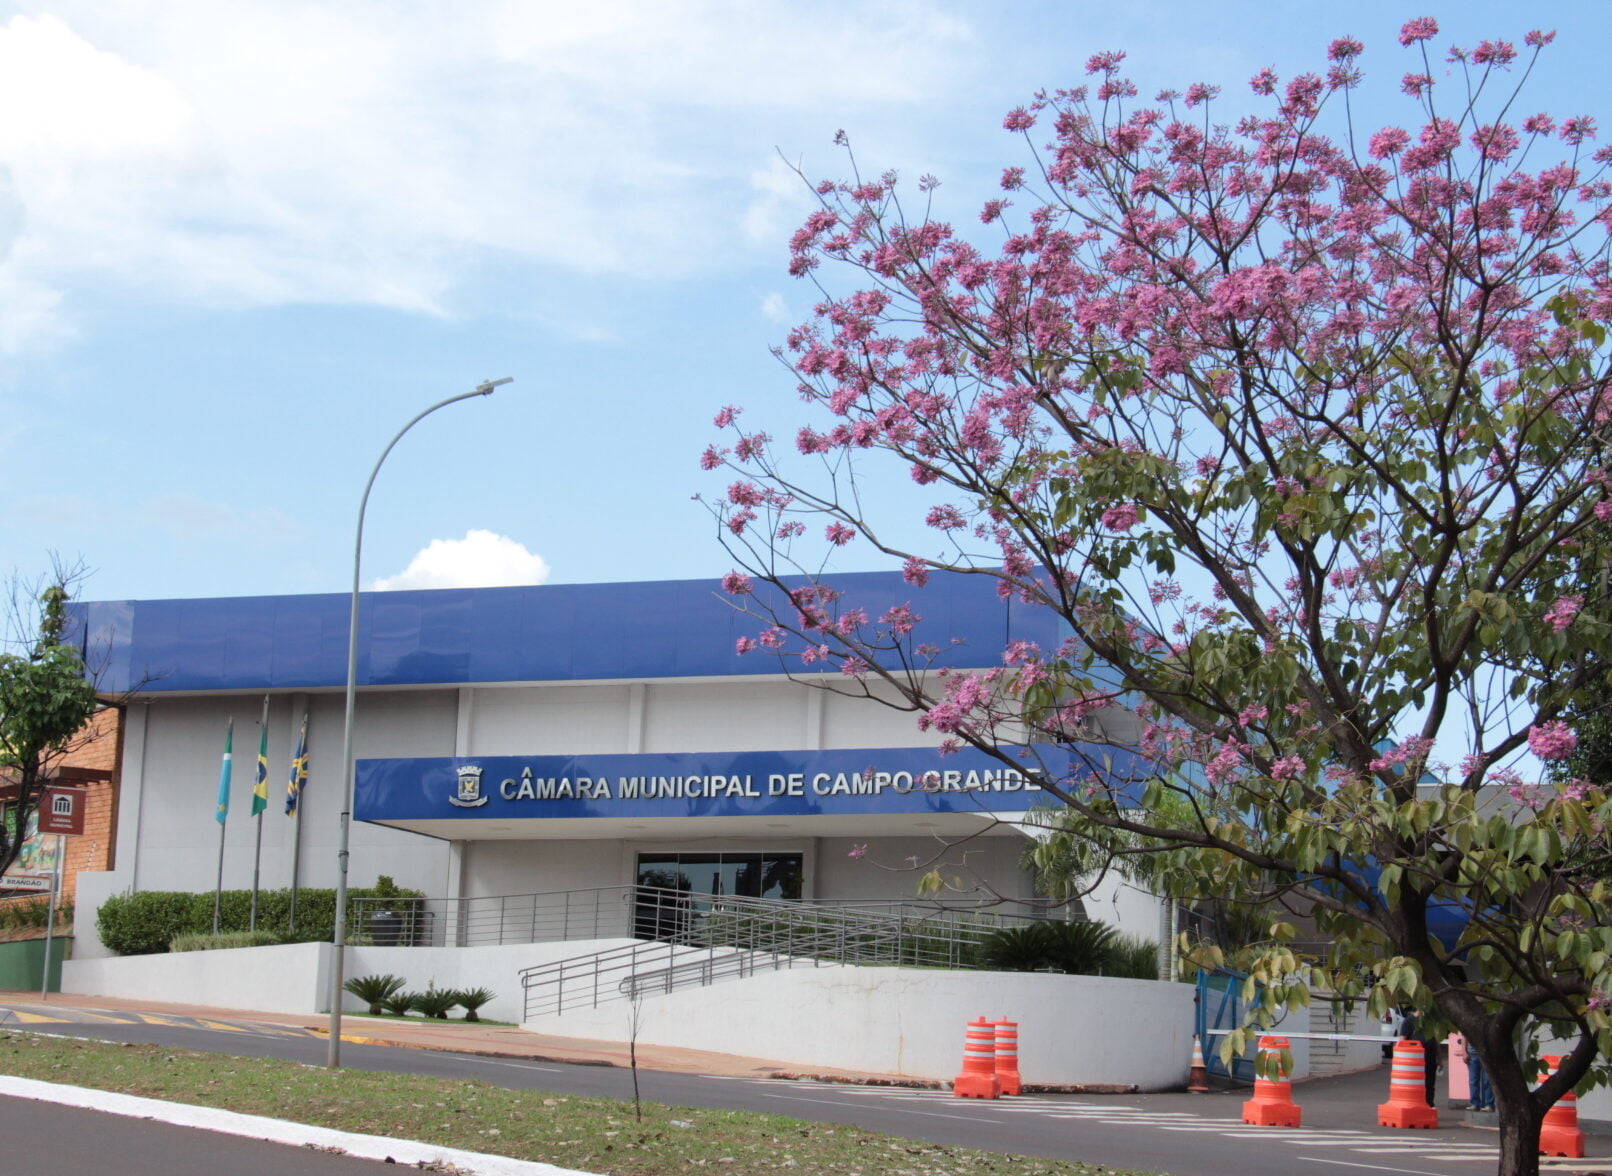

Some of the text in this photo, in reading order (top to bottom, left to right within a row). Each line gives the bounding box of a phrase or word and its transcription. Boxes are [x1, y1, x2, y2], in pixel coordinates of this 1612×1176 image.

[500, 766, 1042, 800] CÂMARA MUNICIPAL DE CAMPO GRANDE
